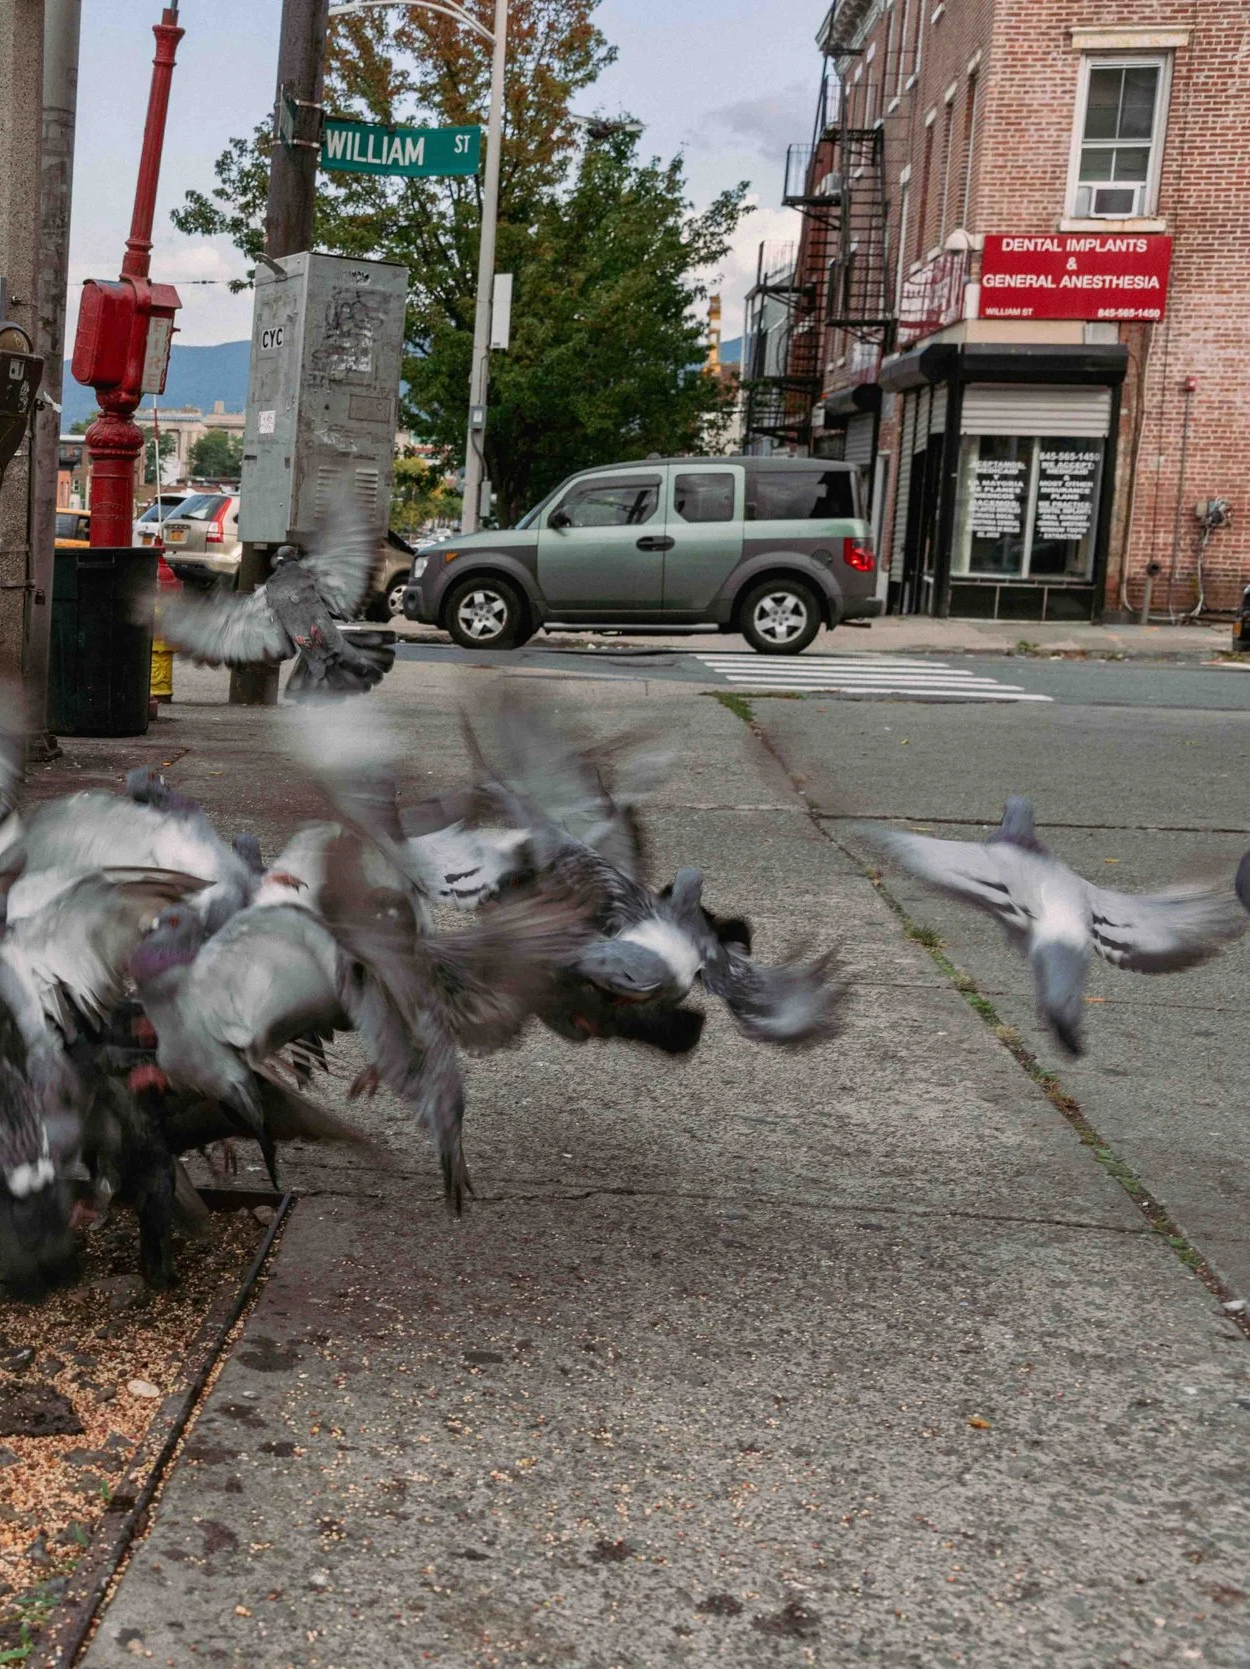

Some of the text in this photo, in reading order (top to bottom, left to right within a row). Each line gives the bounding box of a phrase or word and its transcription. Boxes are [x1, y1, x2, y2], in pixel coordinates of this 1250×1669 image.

[326, 128, 471, 166] WILLIAM ST
[1002, 238, 1148, 252] DENTAL IMPLANTS
[1065, 256, 1078, 270] &
[982, 274, 1160, 289] GENERAL ANESTHESIA
[985, 307, 1033, 316] WILLIAM ST
[1098, 308, 1161, 318] 845-565-1450
[262, 328, 283, 348] CYC
[147, 319, 164, 388] FIRE
